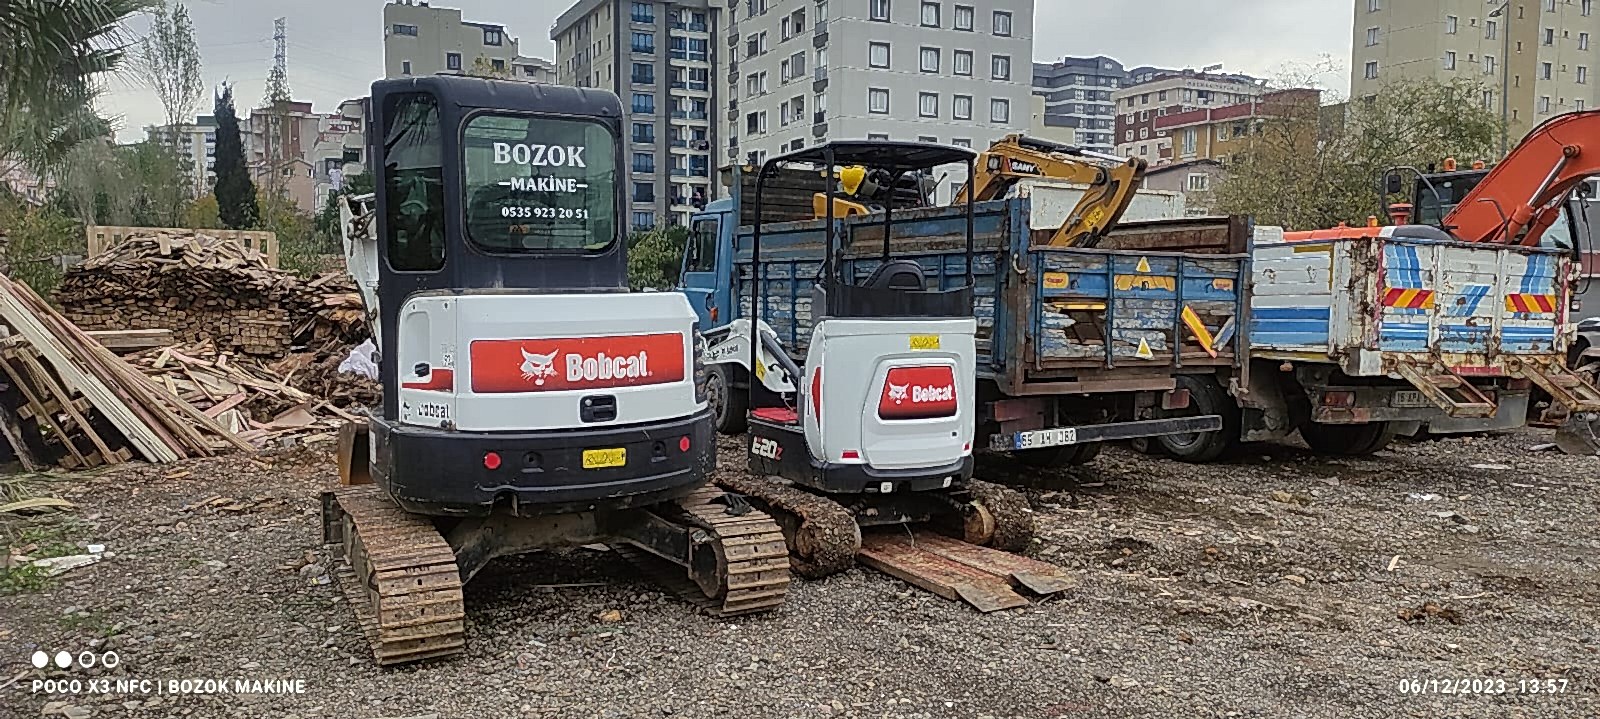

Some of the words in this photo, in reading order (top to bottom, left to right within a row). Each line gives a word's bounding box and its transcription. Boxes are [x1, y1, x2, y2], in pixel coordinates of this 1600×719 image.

[493, 142, 586, 168] BOZOK
[501, 207, 532, 218] 0535
[534, 207, 556, 218] 923
[558, 208, 574, 218] 20
[576, 209, 589, 219] 51
[566, 351, 648, 381] Bobcat
[912, 384, 954, 402] Bobcat
